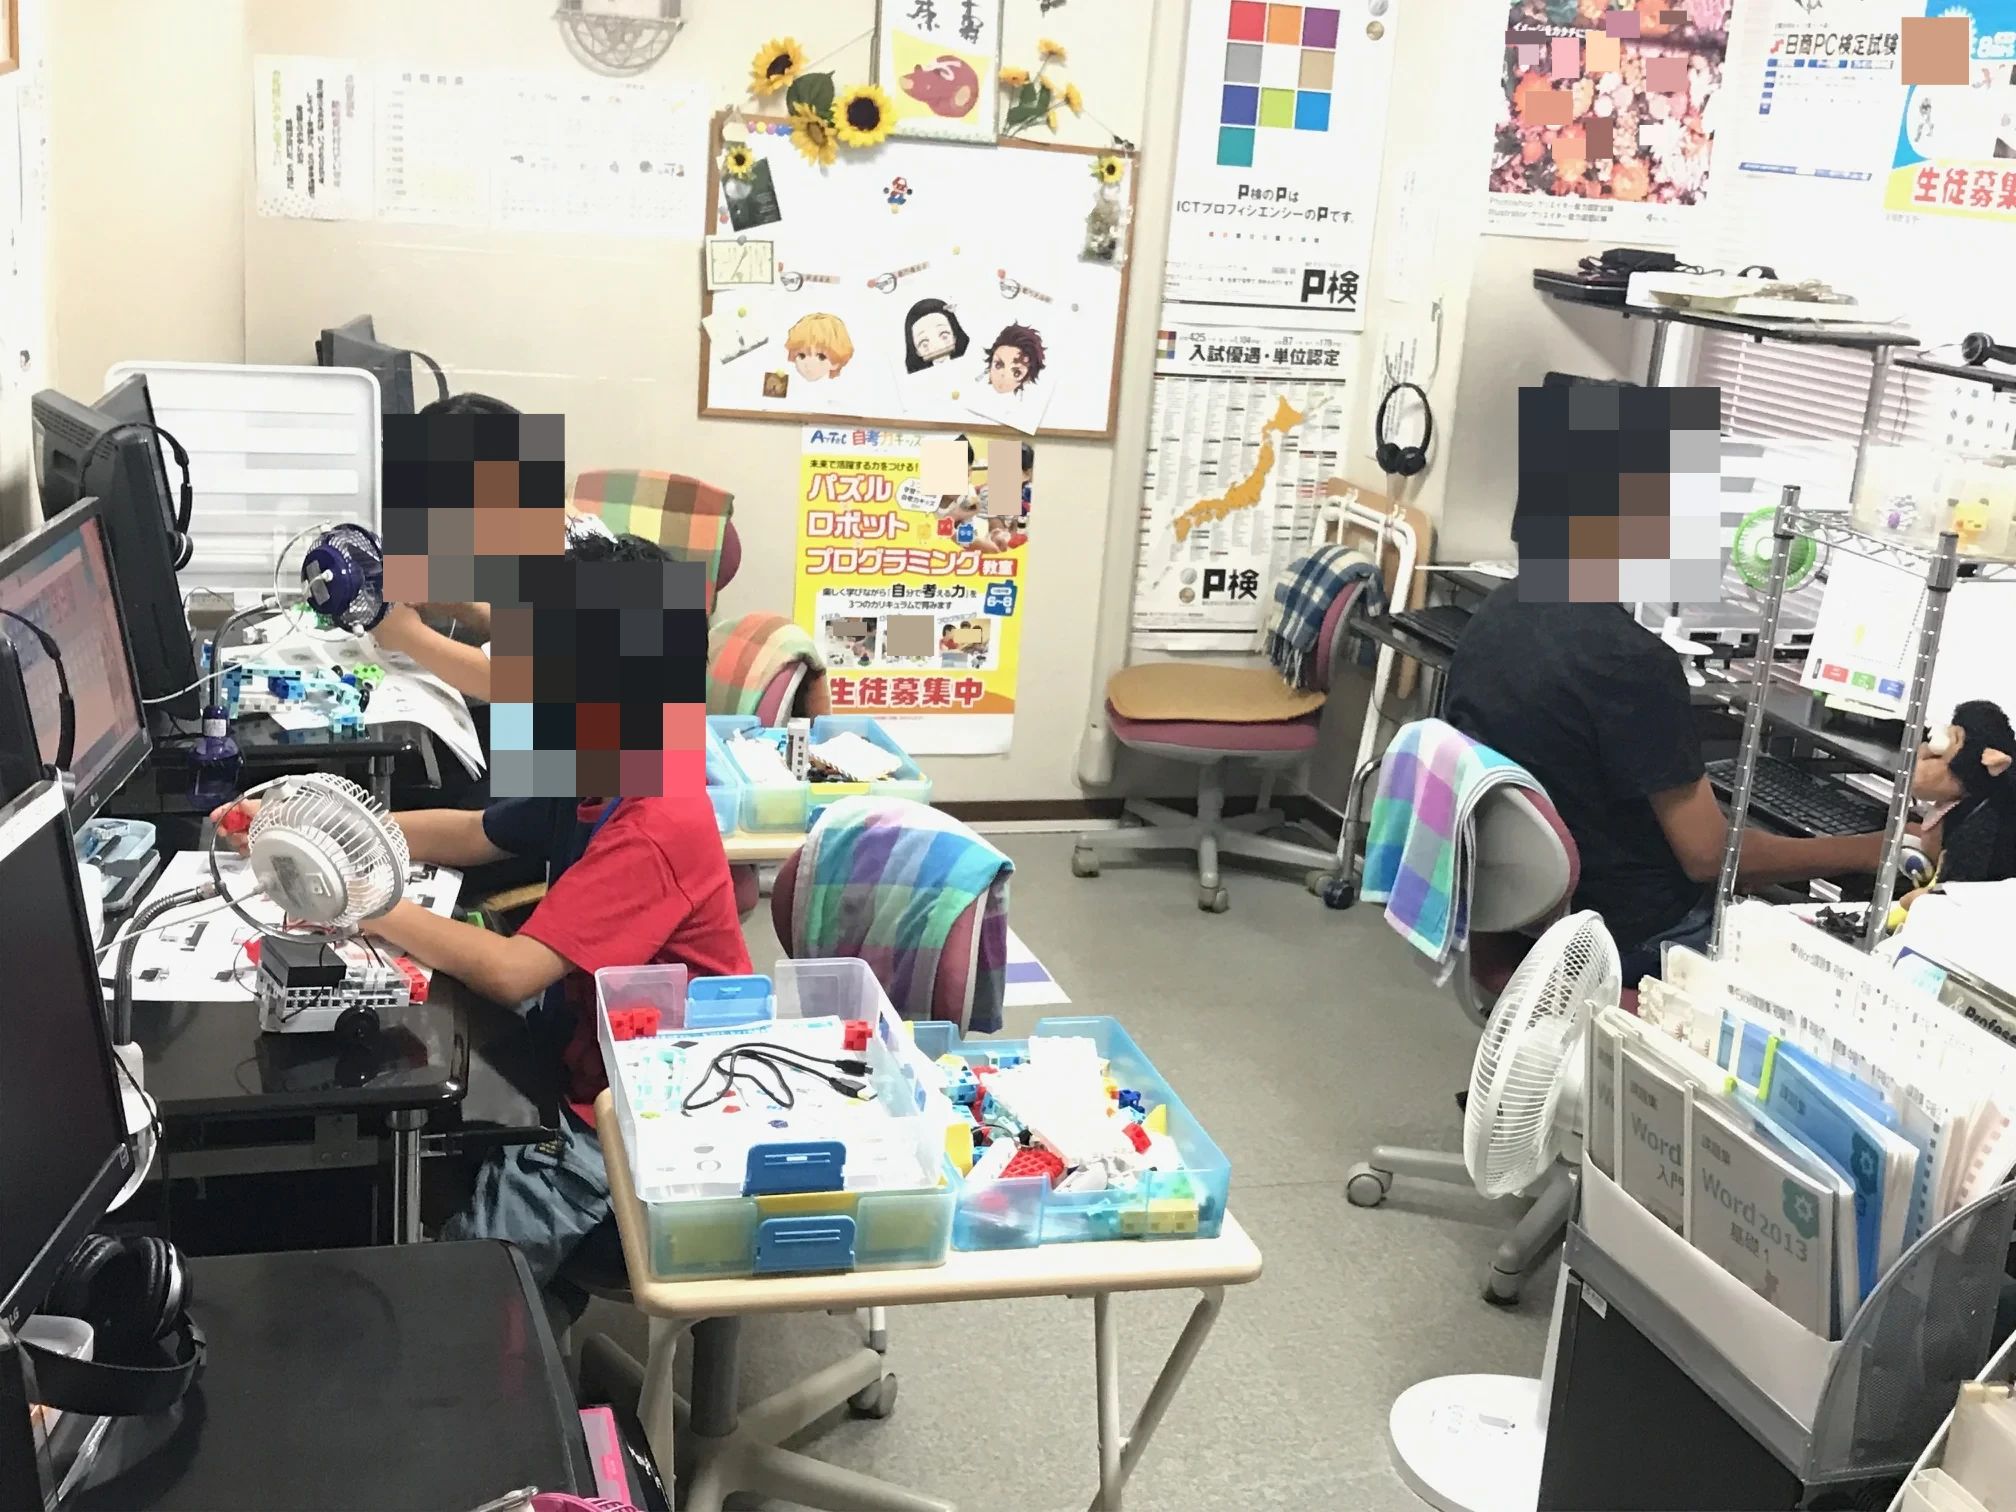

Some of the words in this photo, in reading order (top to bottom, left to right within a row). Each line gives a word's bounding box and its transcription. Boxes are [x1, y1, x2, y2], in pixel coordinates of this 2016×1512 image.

[1785, 33, 1899, 56] 日商PC検定試験
[1238, 184, 1300, 203] P検のPは
[1301, 269, 1359, 304] P検
[1189, 344, 1340, 366] 入試優遇・単位認定
[806, 473, 893, 503] パズル
[807, 510, 909, 540] ロボット
[1202, 569, 1259, 600] P検
[829, 677, 983, 706] 生徒募集中
[1631, 1112, 1682, 1166] Word
